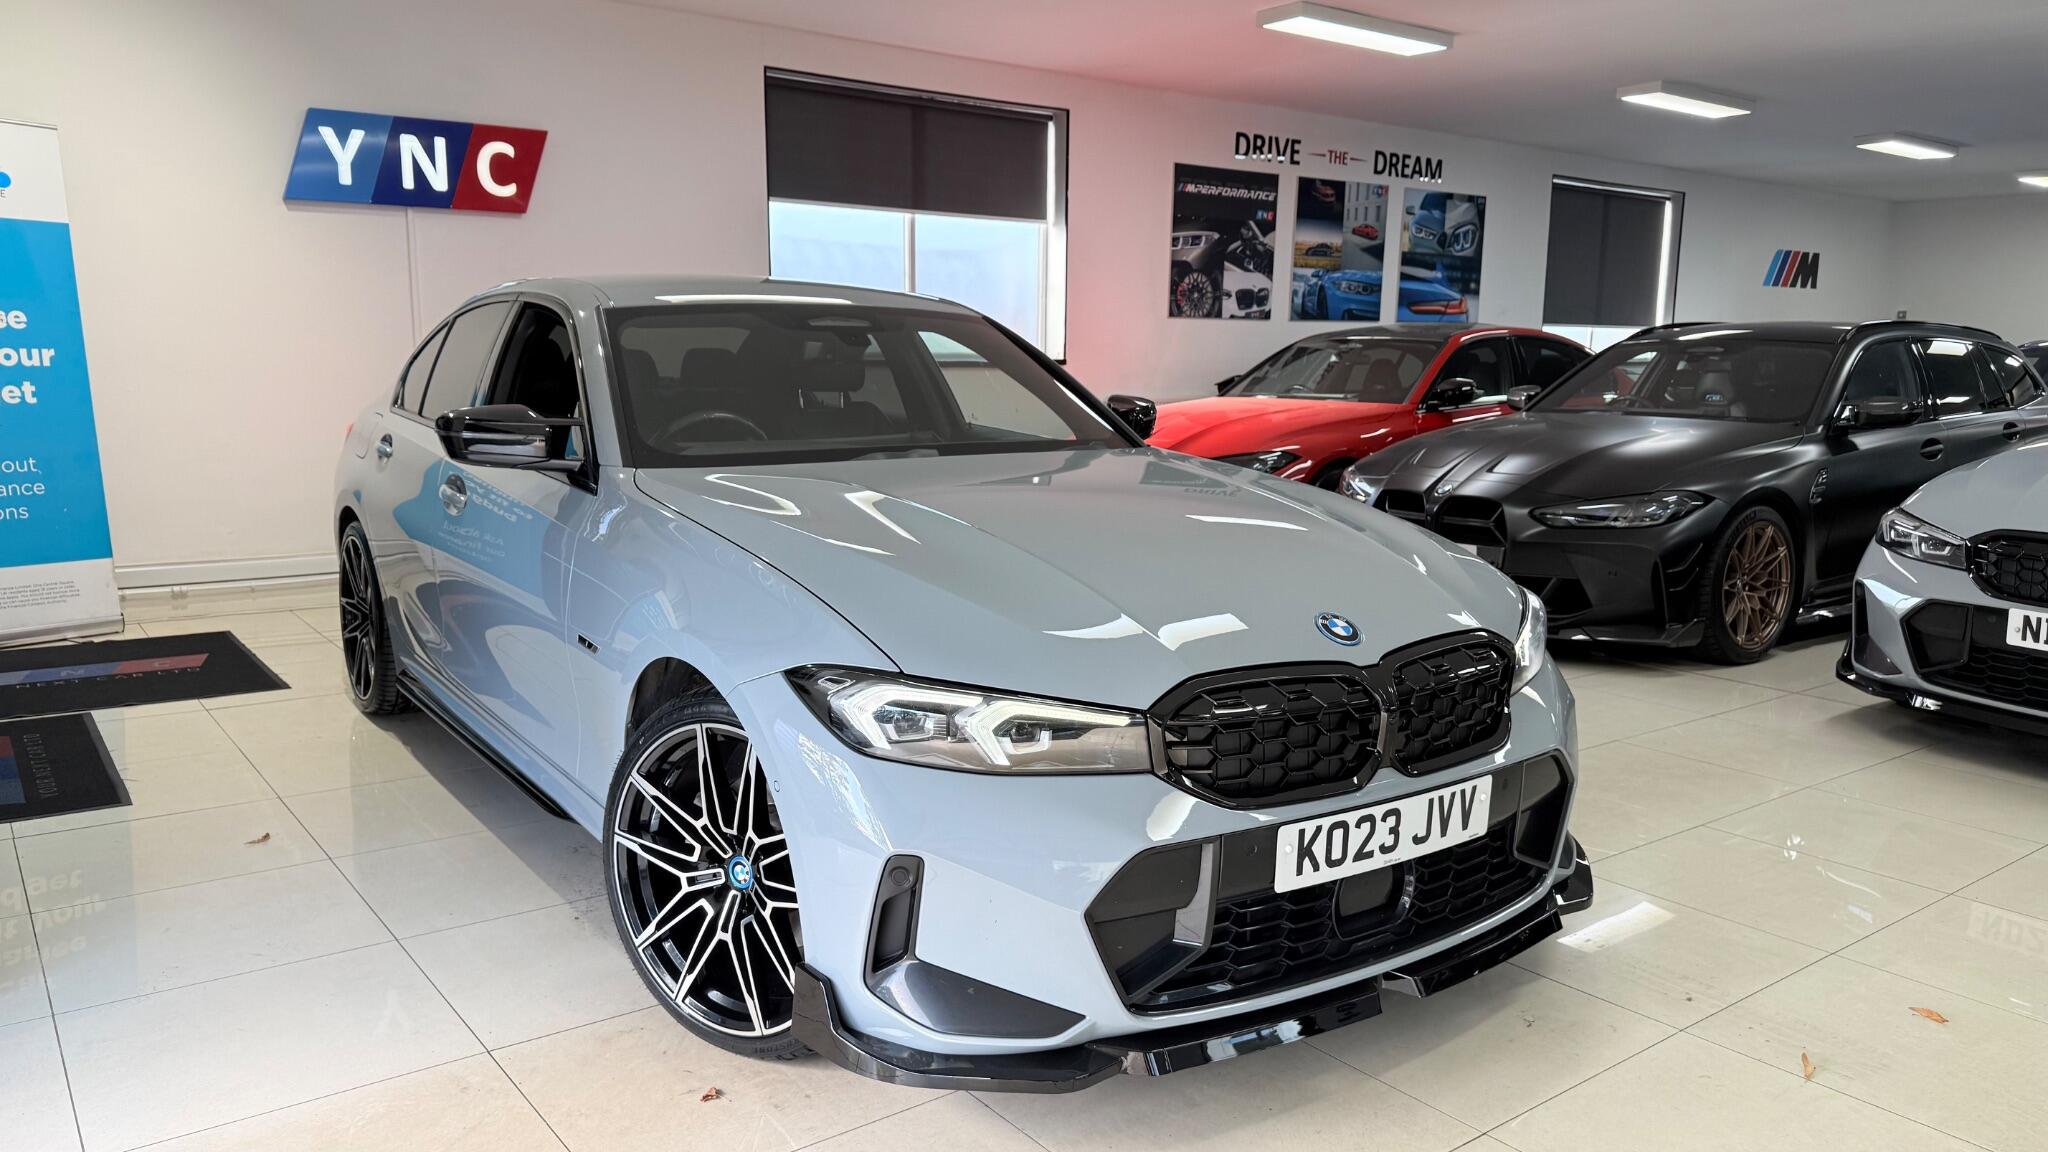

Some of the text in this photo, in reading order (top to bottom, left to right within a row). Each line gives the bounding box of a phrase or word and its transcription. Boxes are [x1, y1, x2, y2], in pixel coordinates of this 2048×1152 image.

[318, 125, 518, 198] YNC
[1235, 131, 1443, 182] DRIVE THE DREAM
[1296, 784, 1478, 877] KO23 JVV
